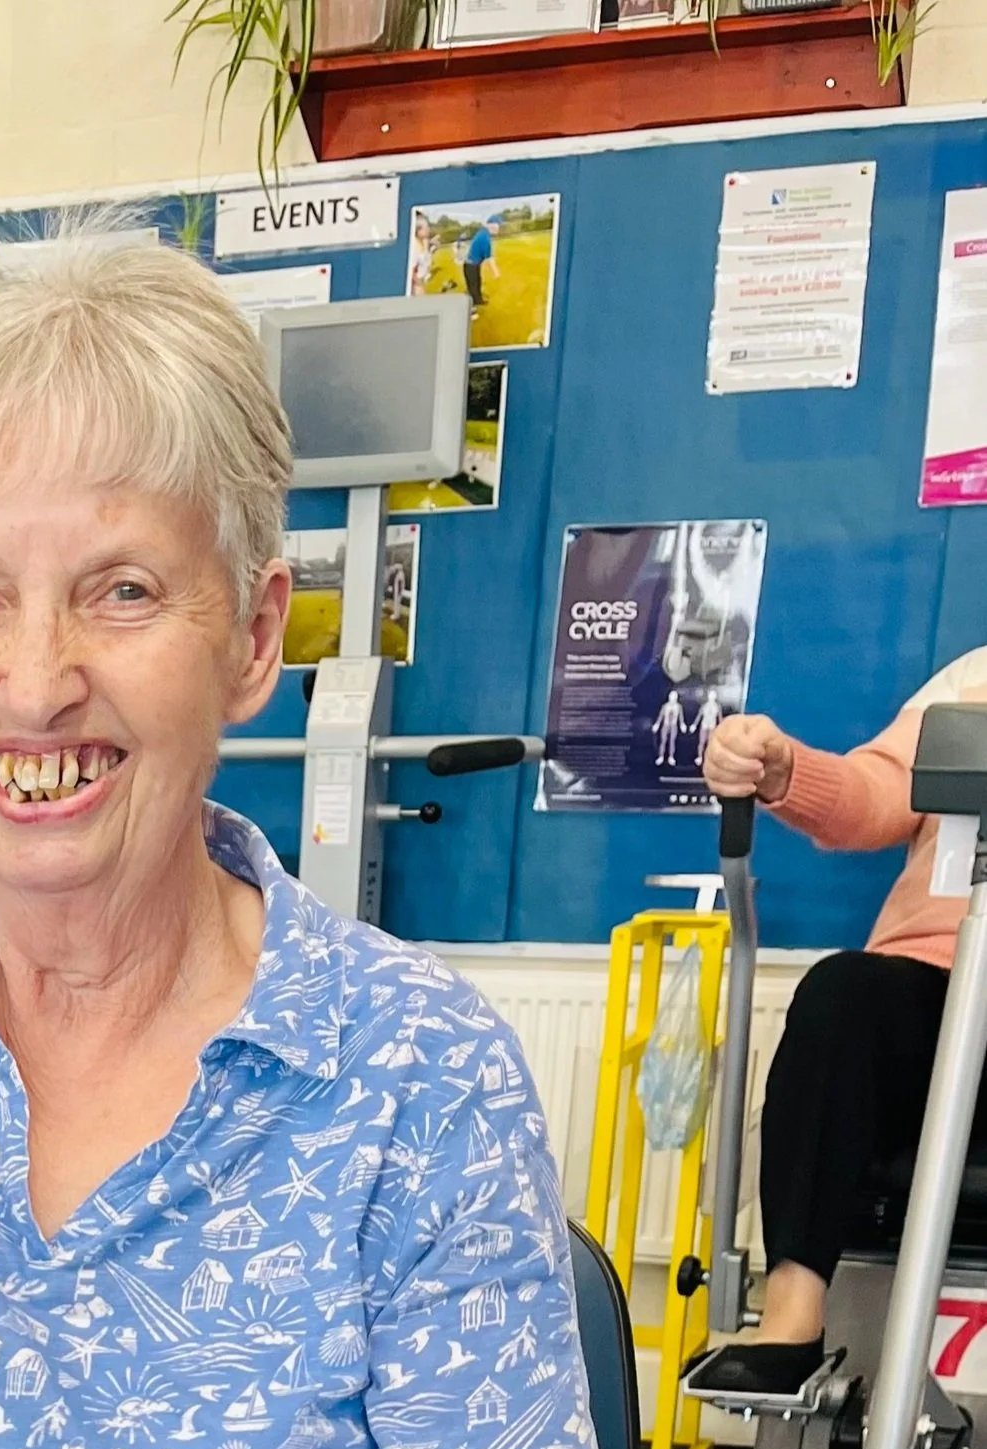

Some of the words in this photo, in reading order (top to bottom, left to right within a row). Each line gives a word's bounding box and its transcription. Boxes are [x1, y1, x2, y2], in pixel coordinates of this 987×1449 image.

[253, 196, 360, 232] EVENTS
[571, 601, 638, 620] CROSS
[569, 621, 630, 640] CYCLE
[935, 1298, 987, 1377] 7
